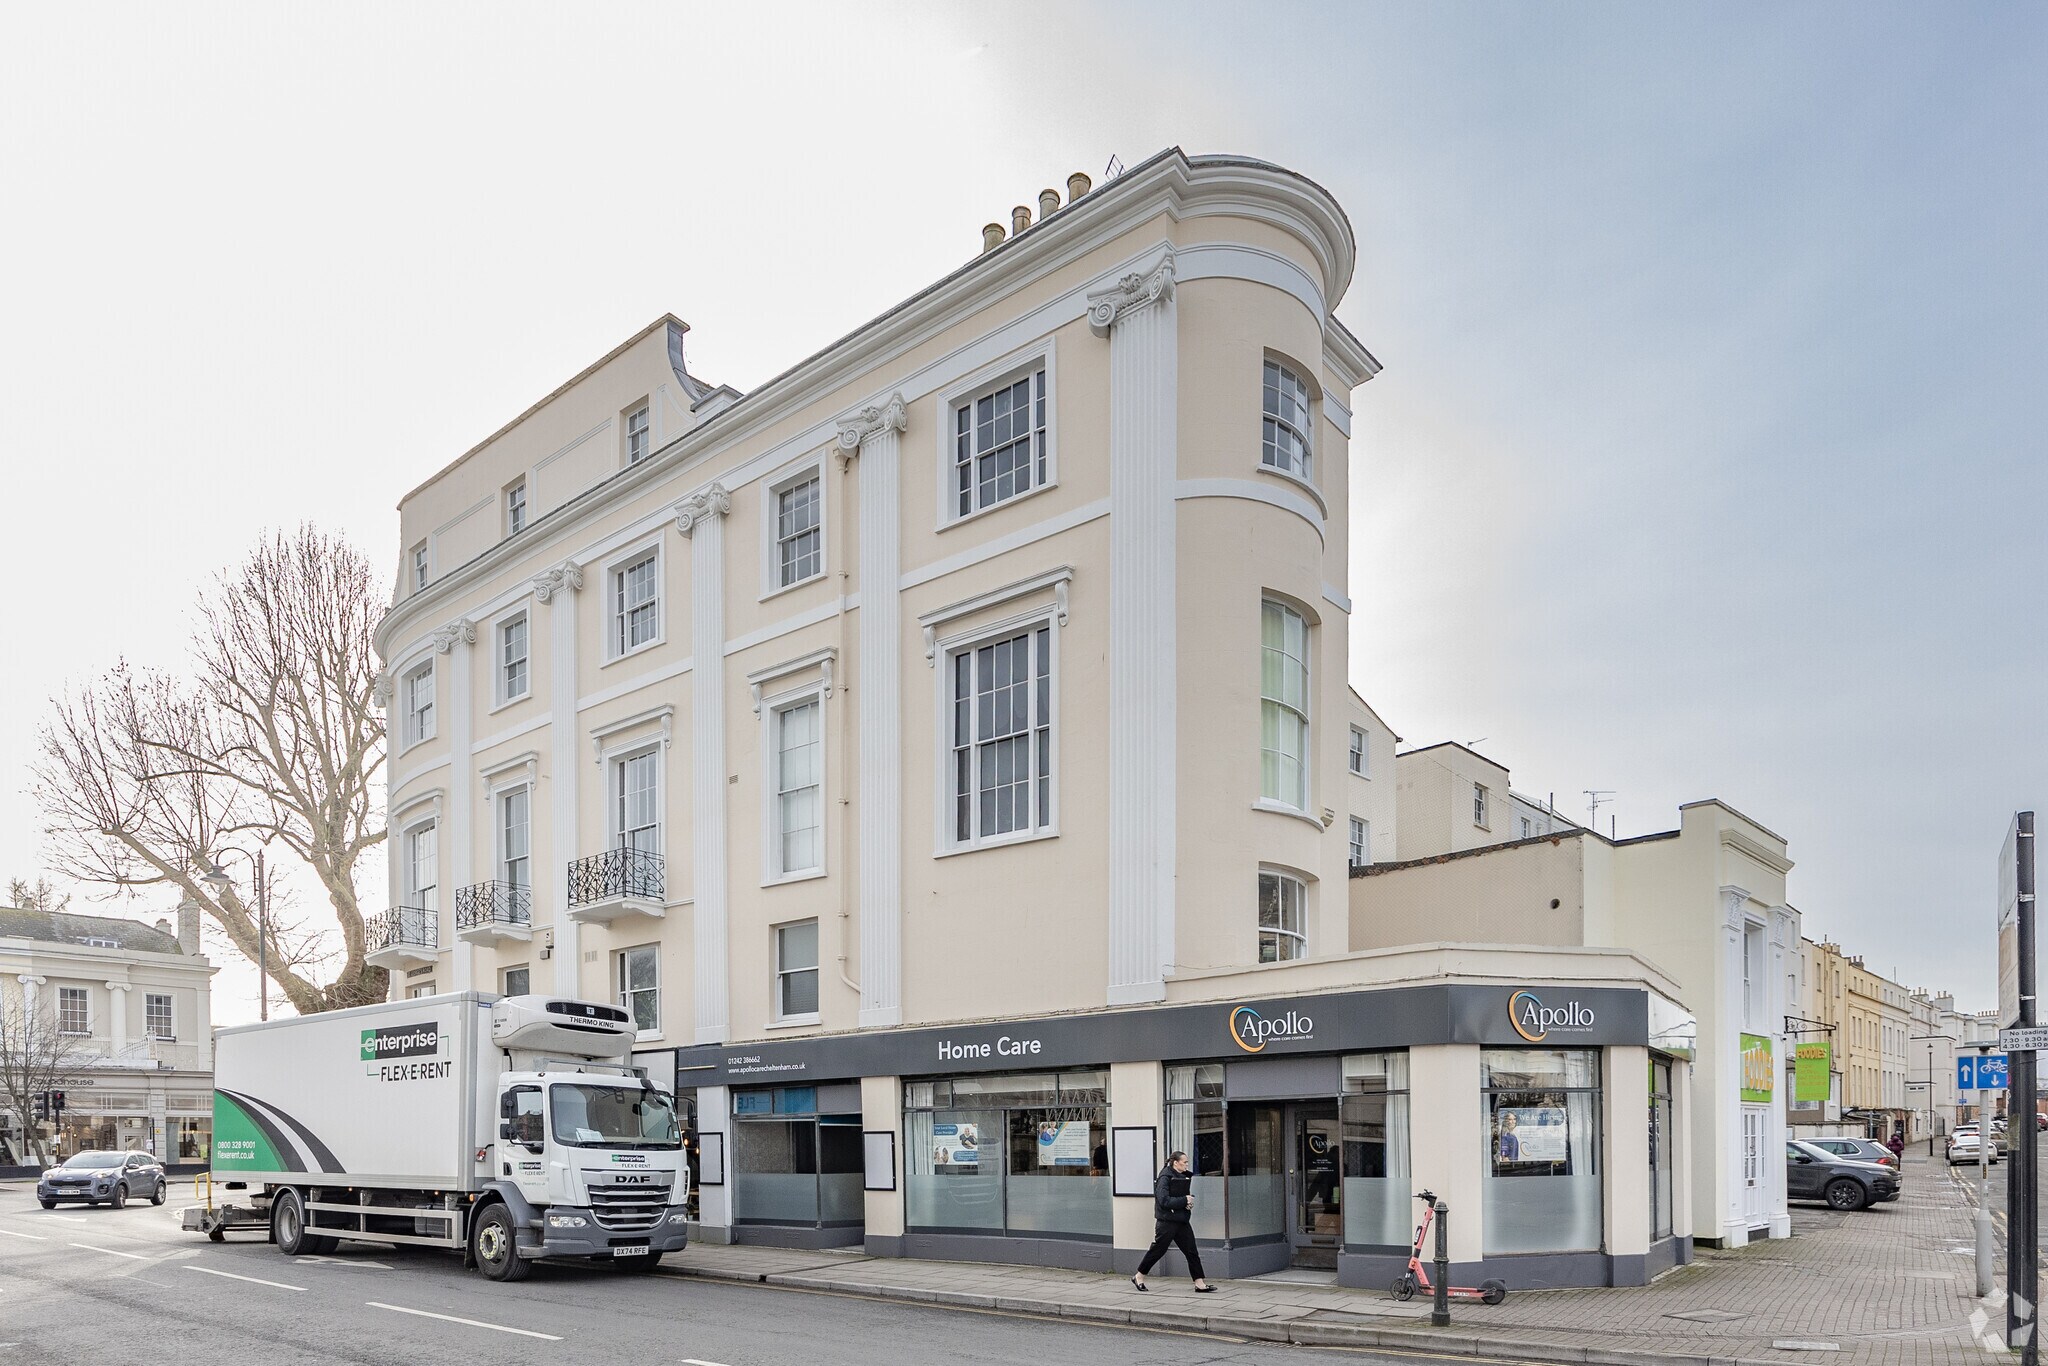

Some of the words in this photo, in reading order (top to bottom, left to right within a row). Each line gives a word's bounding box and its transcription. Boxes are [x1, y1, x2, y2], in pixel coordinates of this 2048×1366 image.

[569, 1016, 597, 1026] THERMO
[1521, 1001, 1594, 1032] Apollo
[1241, 1011, 1313, 1044] Apollo
[2021, 1028, 2047, 1036] loading
[361, 1029, 436, 1053] enterprise
[938, 1041, 991, 1060] Home
[997, 1036, 1041, 1056] Care
[1797, 1047, 1827, 1059] FOODIES
[727, 1057, 742, 1065] 01242
[380, 1061, 452, 1082] FLEX-E-RENT
[728, 1062, 806, 1075] www.apollocarecheltenham.co.uk
[218, 1141, 231, 1149] 0800
[232, 1141, 242, 1149] 328
[243, 1141, 255, 1149] 9001
[217, 1150, 255, 1160] flexerent.co.uk
[615, 1176, 650, 1184] DAF
